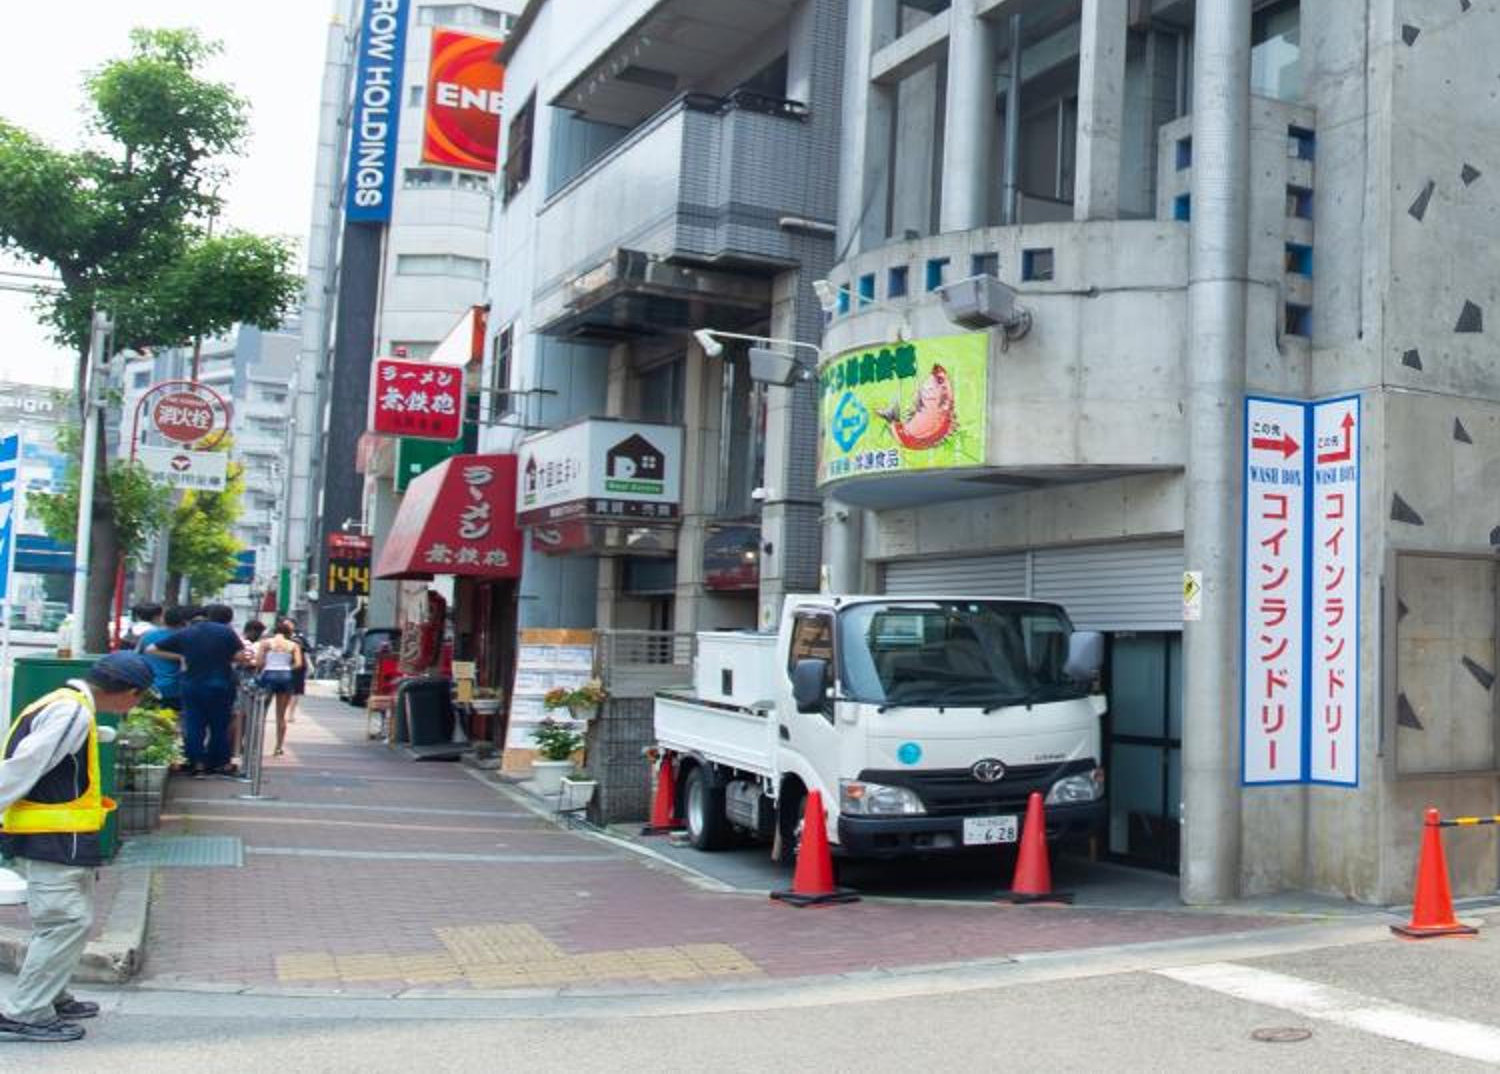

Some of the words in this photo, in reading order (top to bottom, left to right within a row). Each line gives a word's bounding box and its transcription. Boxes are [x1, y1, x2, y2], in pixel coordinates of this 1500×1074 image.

[355, 67, 391, 207] HOLDINGS
[381, 366, 453, 387] ラーメン
[158, 405, 212, 430] 消火栓
[1252, 422, 1280, 437] この先
[1249, 466, 1279, 483] WASH
[1260, 493, 1289, 770] コインランドリー
[1324, 493, 1346, 770] コインランドリー
